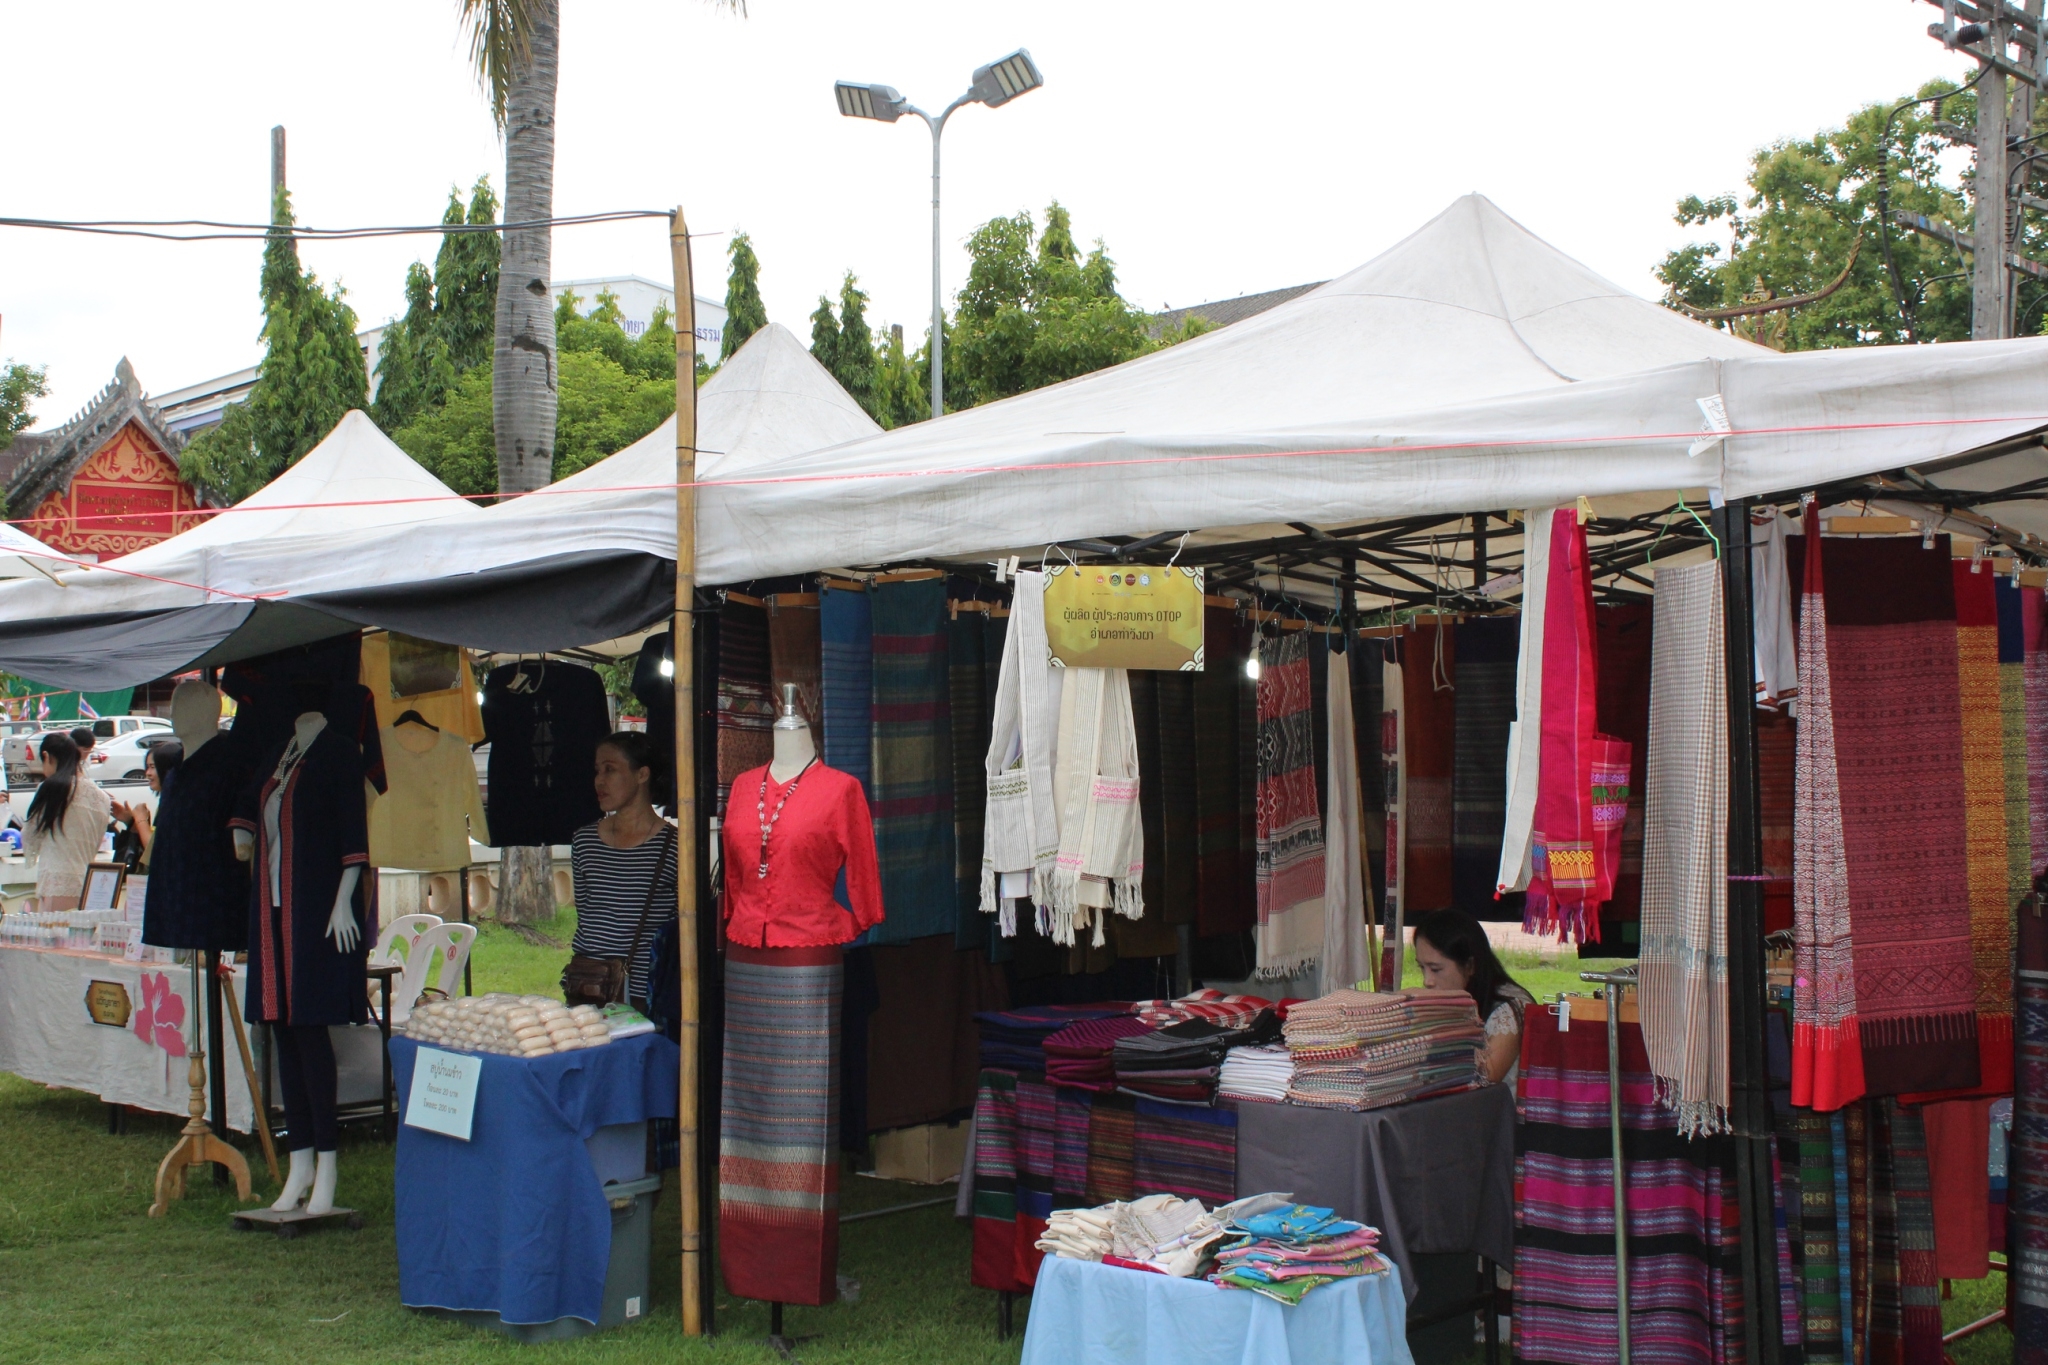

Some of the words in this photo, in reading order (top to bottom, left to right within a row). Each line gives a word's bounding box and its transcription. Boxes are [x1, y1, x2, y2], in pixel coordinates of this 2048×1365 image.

[1063, 607, 1090, 624] ผู้ผลิต
[1092, 607, 1154, 624] ผู้ประกอบการ
[1156, 610, 1182, 622] OTOP
[1090, 627, 1154, 641] อำเภอท่าวังผา
[430, 1058, 463, 1080] สบู่น้ำนมข้าว
[442, 1087, 449, 1096] 20
[449, 1090, 459, 1098] บาท
[438, 1103, 448, 1113] 200
[448, 1106, 457, 1115] บาท
